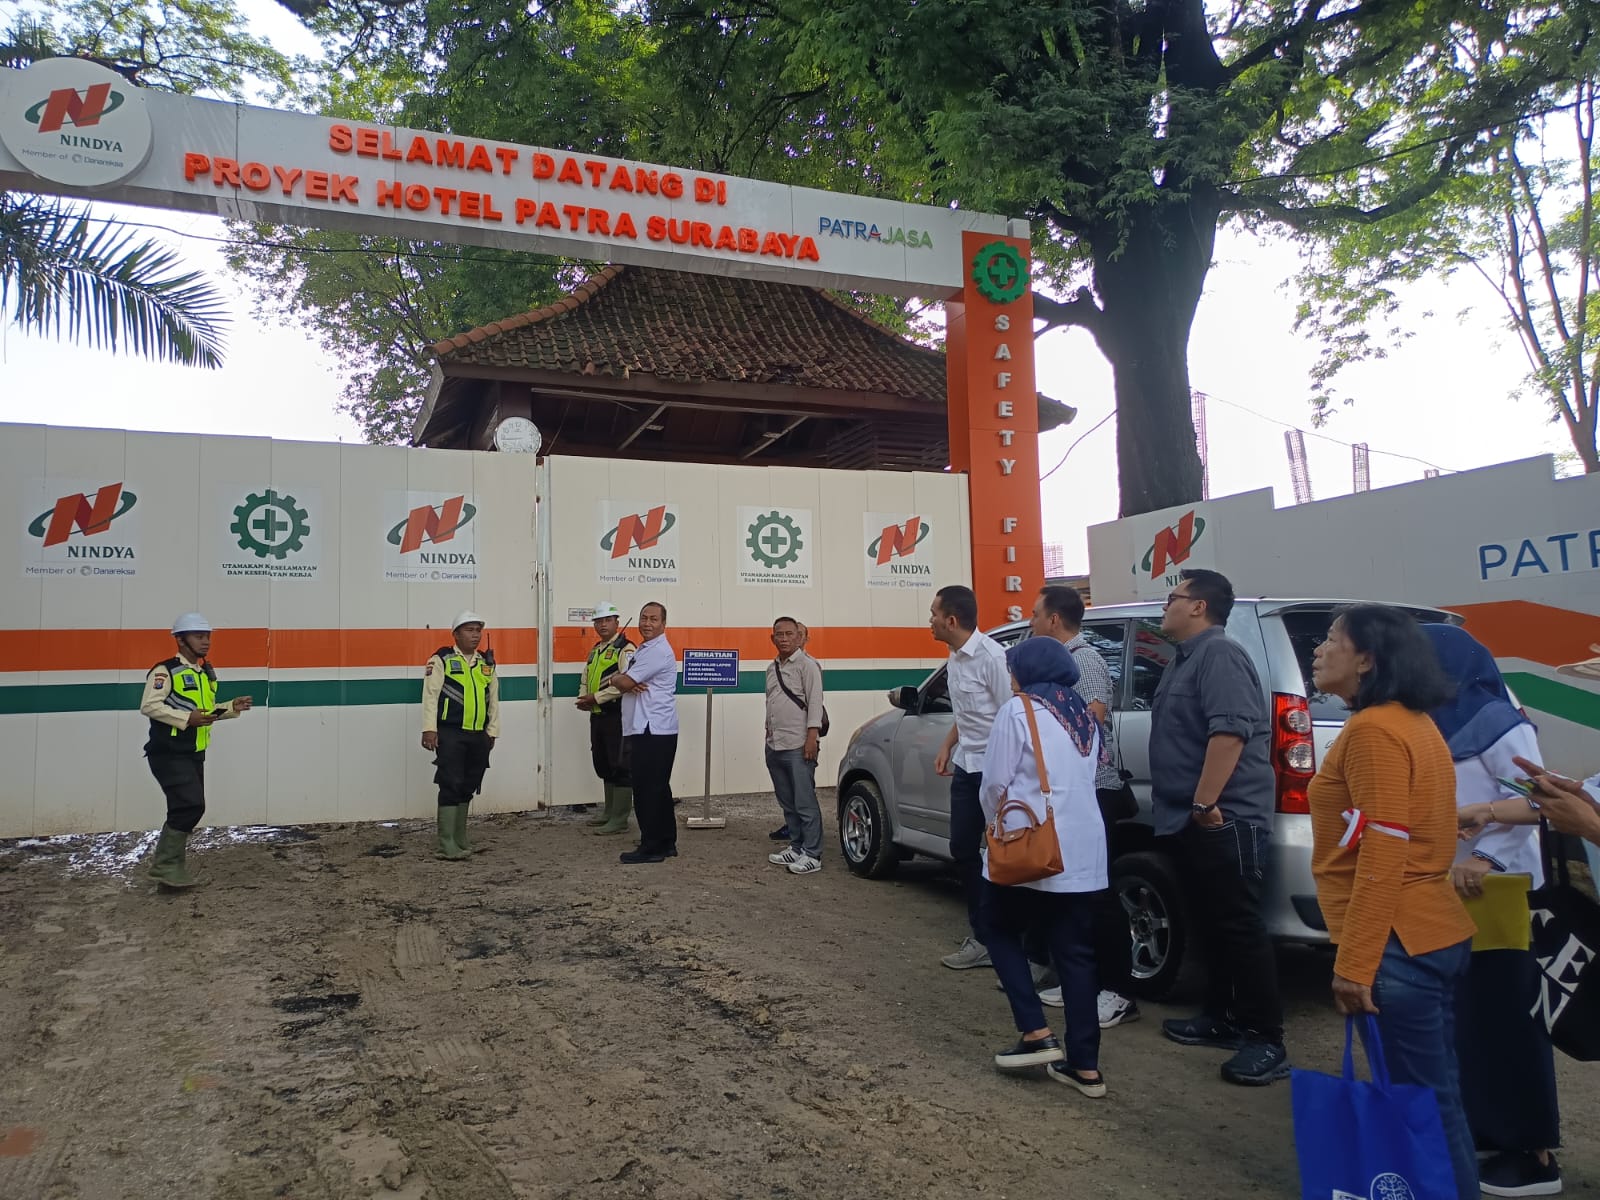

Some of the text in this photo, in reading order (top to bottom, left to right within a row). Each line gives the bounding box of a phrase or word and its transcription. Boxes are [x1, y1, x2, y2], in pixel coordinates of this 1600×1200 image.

[60, 134, 123, 153] NINDYA
[21, 148, 57, 159] Member
[58, 153, 69, 161] of
[329, 124, 727, 206] SELAMAT DATANG DI
[184, 152, 820, 262] PROYEK HOTEL PATRA SURABAYA
[994, 314, 1017, 475] SAFETY
[67, 545, 135, 558] NINDYA
[420, 553, 476, 565] NINDYA
[628, 557, 676, 569] NINDYA
[25, 567, 136, 576] Member of Danareksa
[385, 571, 417, 579] Member
[890, 564, 931, 574] NINDYA
